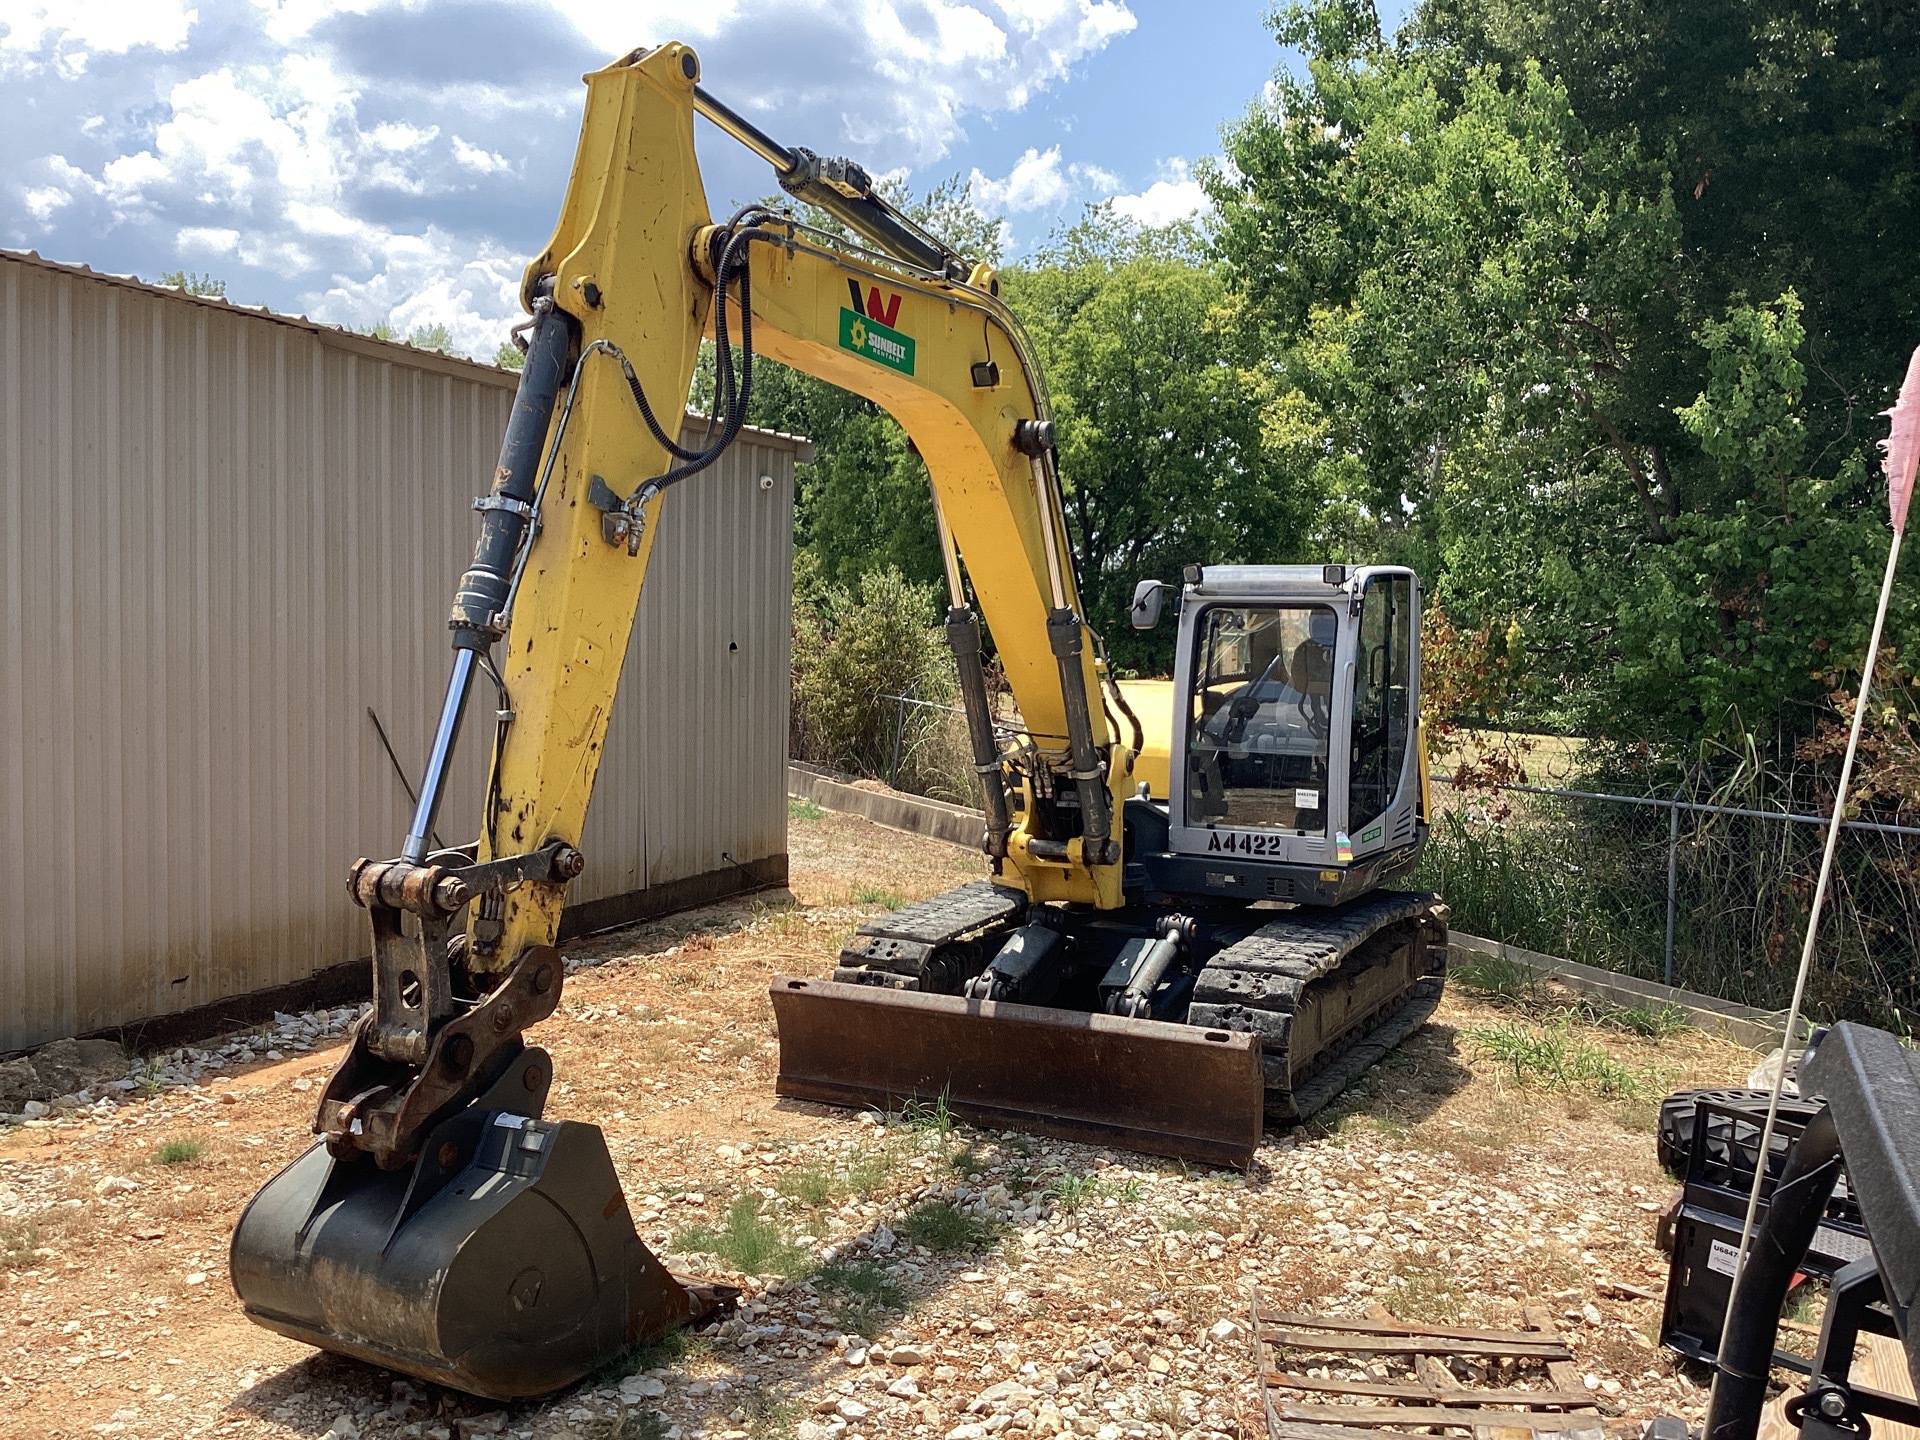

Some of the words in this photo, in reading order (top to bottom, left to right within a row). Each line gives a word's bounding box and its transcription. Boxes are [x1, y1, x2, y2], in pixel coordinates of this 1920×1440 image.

[868, 331, 906, 360] SUNBELT
[872, 347, 900, 364] RENTALS
[1208, 831, 1281, 856] A4422
